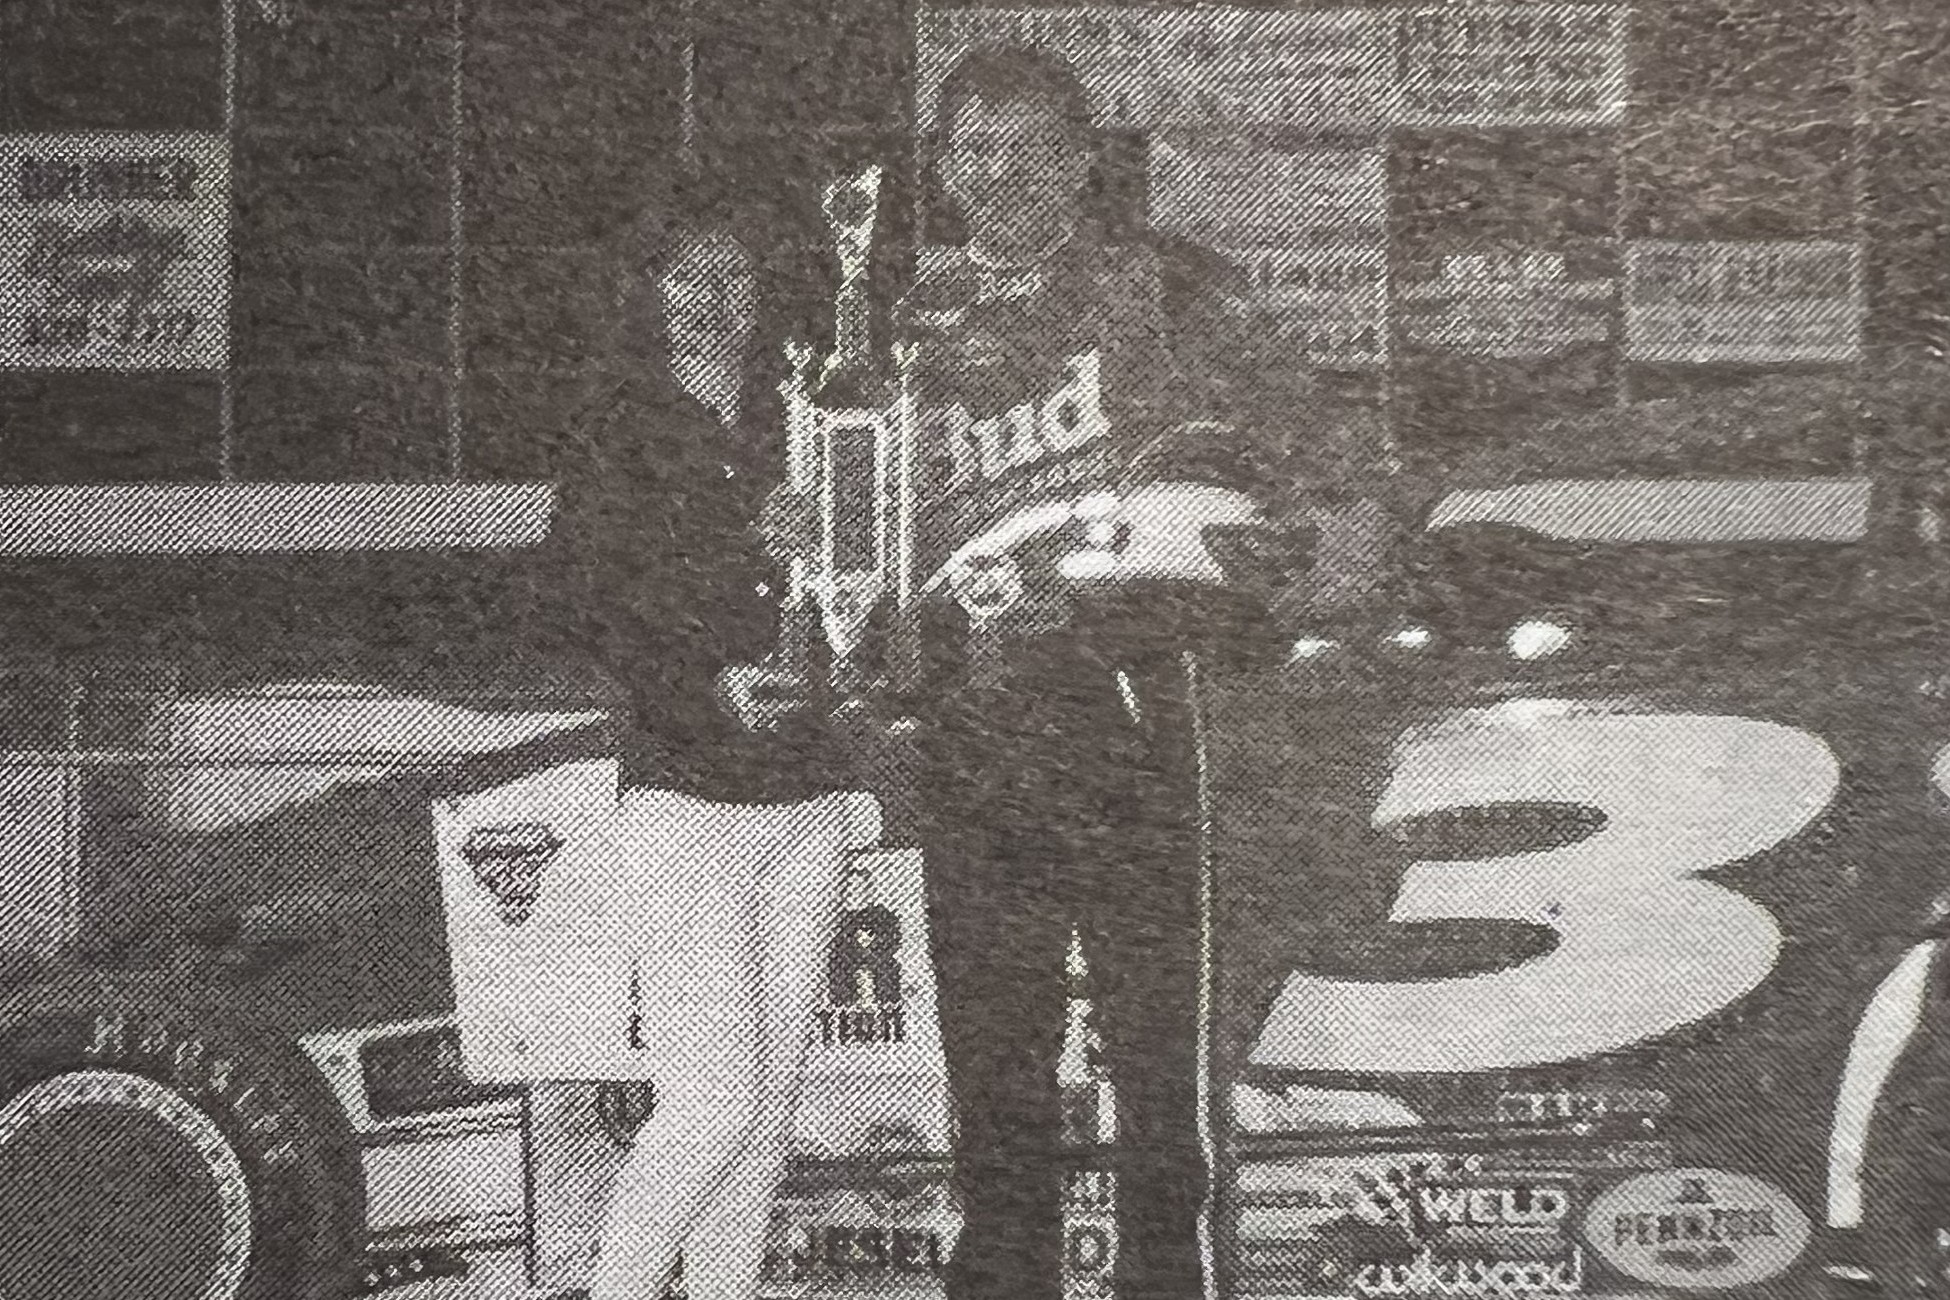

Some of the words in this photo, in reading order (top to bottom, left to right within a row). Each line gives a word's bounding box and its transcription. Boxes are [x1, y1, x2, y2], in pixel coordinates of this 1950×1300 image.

[1247, 699, 1841, 1073] 3
[1419, 1186, 1569, 1223] WELD
[1613, 1207, 1778, 1246] PENNZOIL
